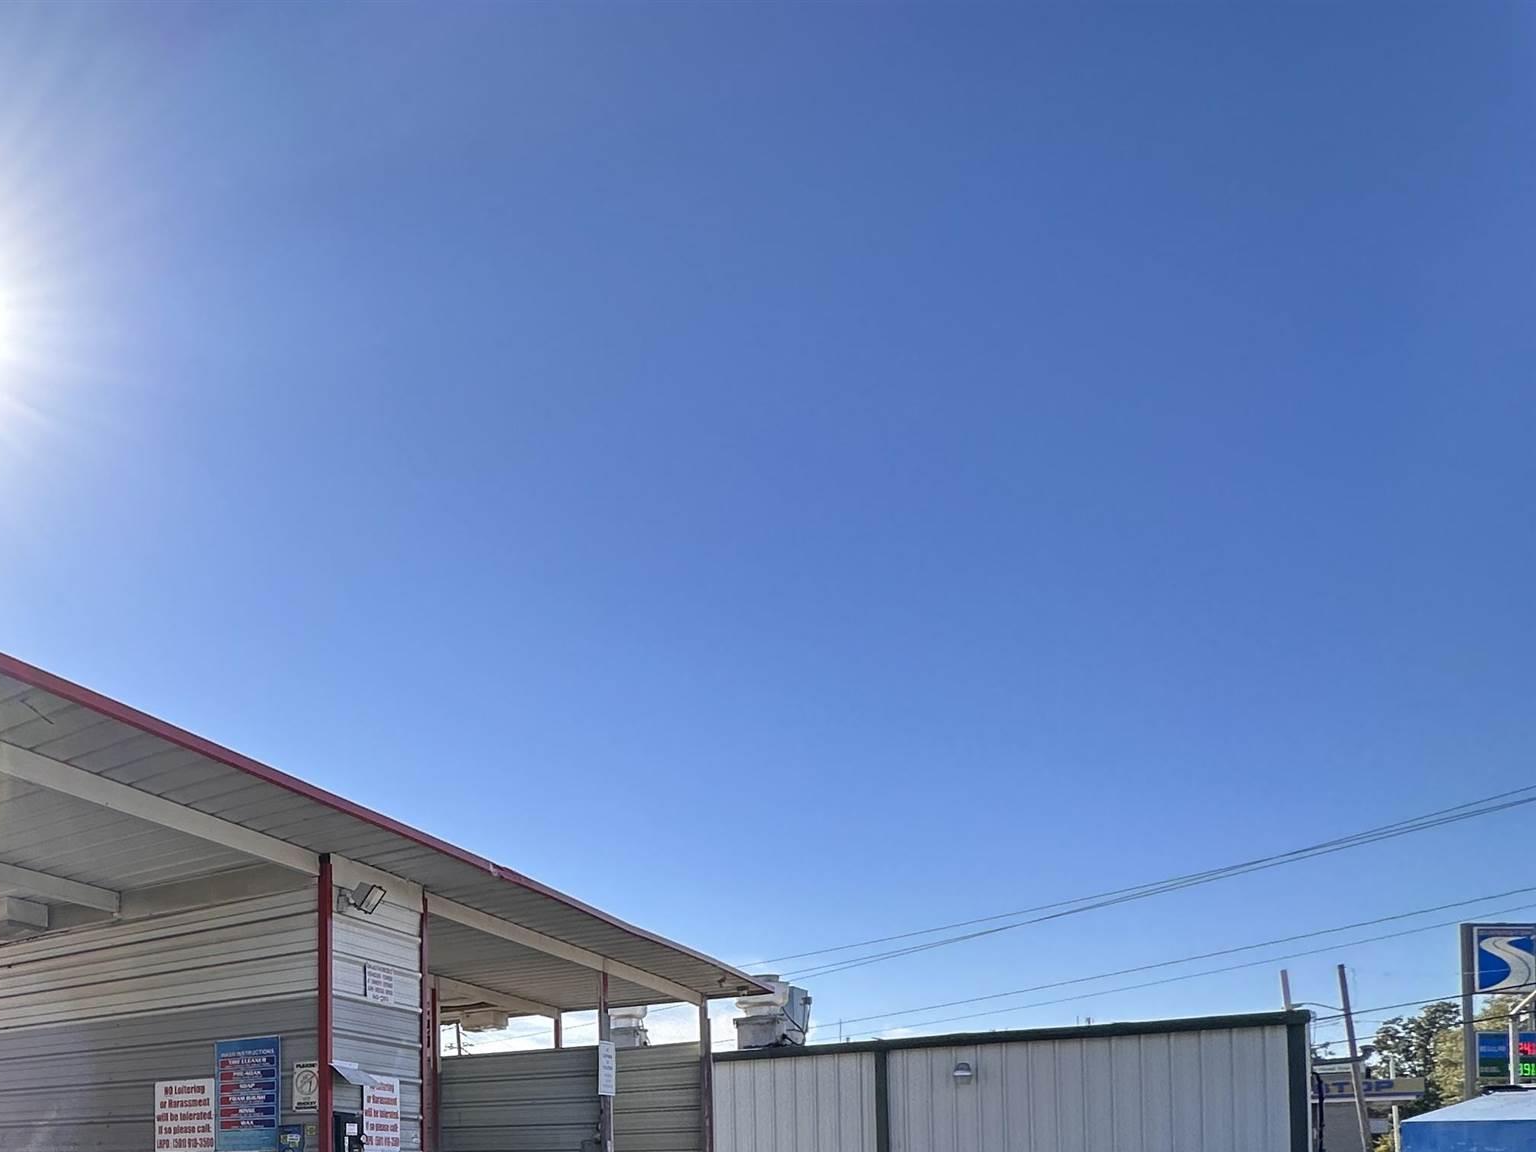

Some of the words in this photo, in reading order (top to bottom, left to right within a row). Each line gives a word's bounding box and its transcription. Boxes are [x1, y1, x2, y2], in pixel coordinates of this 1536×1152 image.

[164, 1085, 174, 1097] NO
[174, 1084, 206, 1096] Loitering
[159, 1100, 168, 1110] or
[168, 1097, 211, 1109] Harassment
[156, 1112, 169, 1123] will
[169, 1111, 179, 1122] be
[164, 1125, 173, 1135] so
[172, 1124, 196, 1136] please
